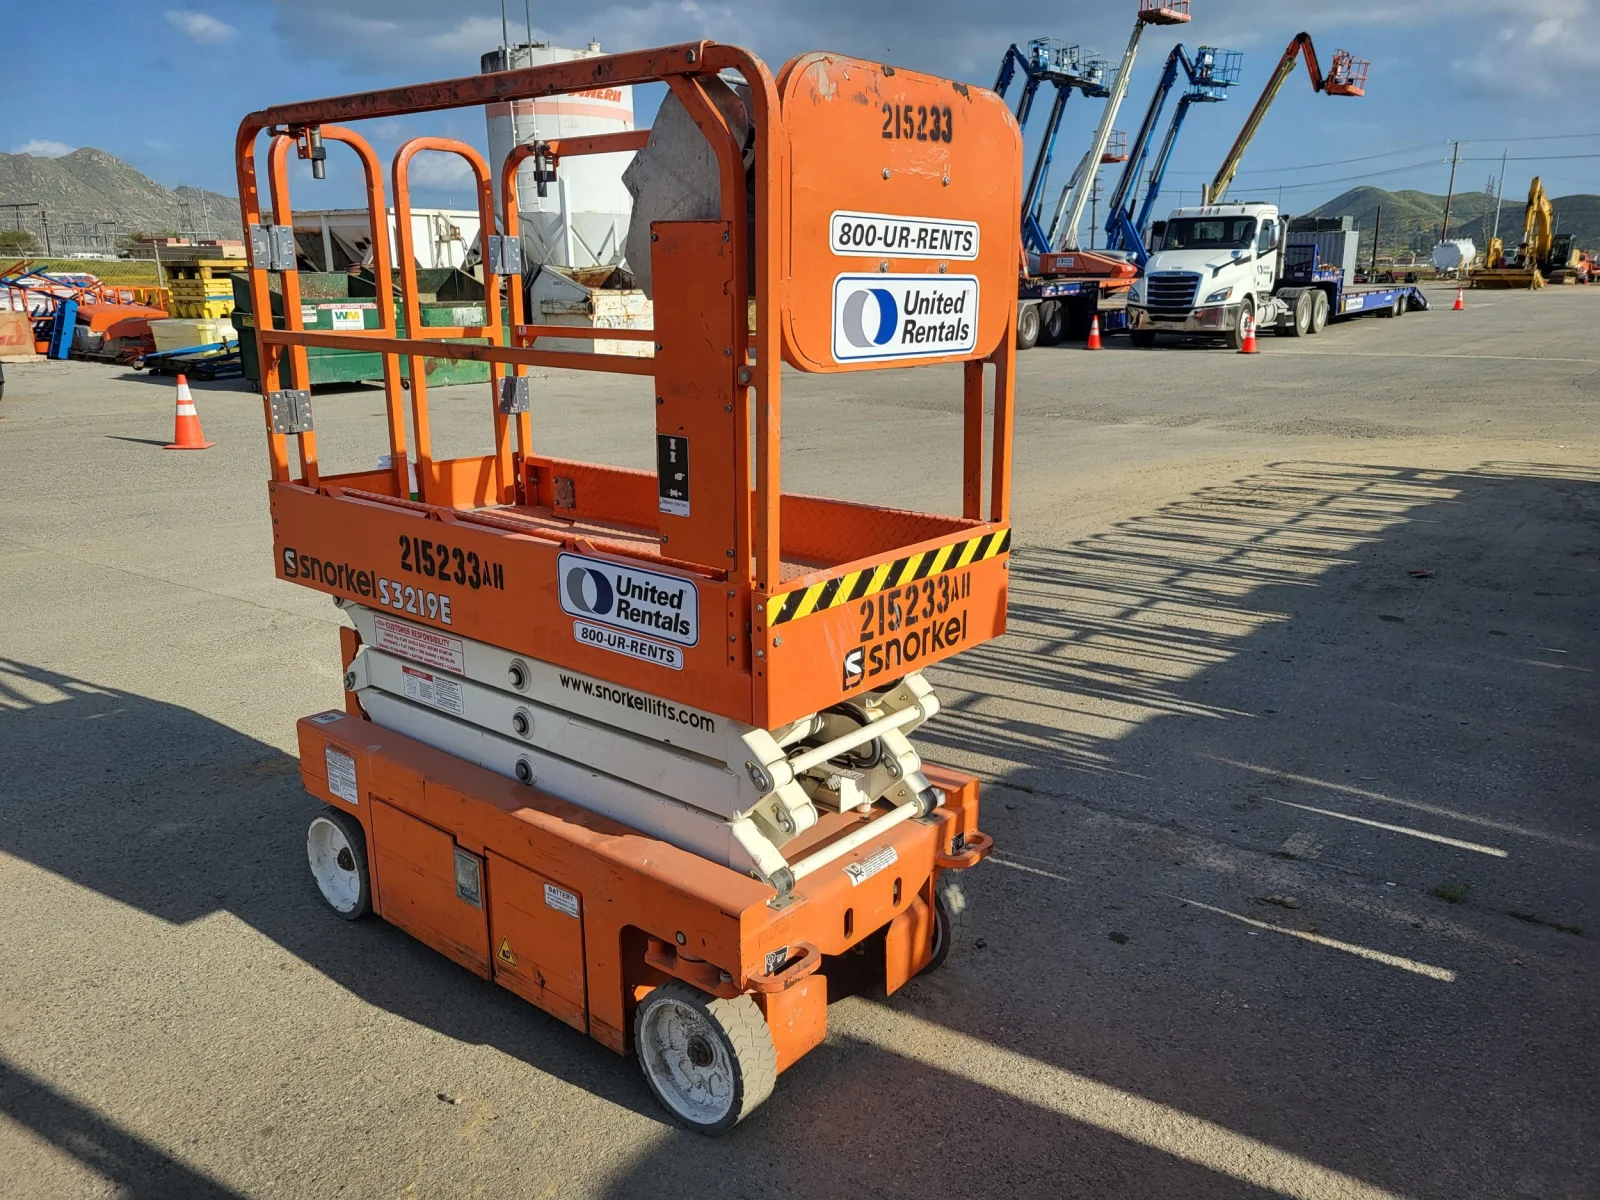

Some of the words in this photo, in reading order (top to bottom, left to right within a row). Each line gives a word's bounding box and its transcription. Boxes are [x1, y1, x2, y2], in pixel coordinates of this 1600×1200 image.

[882, 104, 952, 143] 215233
[838, 222, 973, 251] 800-UR-RENTS
[335, 311, 360, 320] WM
[904, 290, 966, 315] United
[901, 318, 969, 344] Rentals
[300, 554, 377, 598] snorkel
[616, 575, 684, 610] United
[378, 577, 453, 625] S3219E
[616, 598, 690, 635] Rentals
[386, 622, 411, 635] CUSTOMER
[411, 630, 450, 647] RESPONSIBILITY
[581, 627, 675, 663] 800-UR-RENTS
[868, 609, 967, 678] snorkel
[559, 673, 715, 733] www.snorkellifts.com
[548, 886, 574, 902] BATTERY
